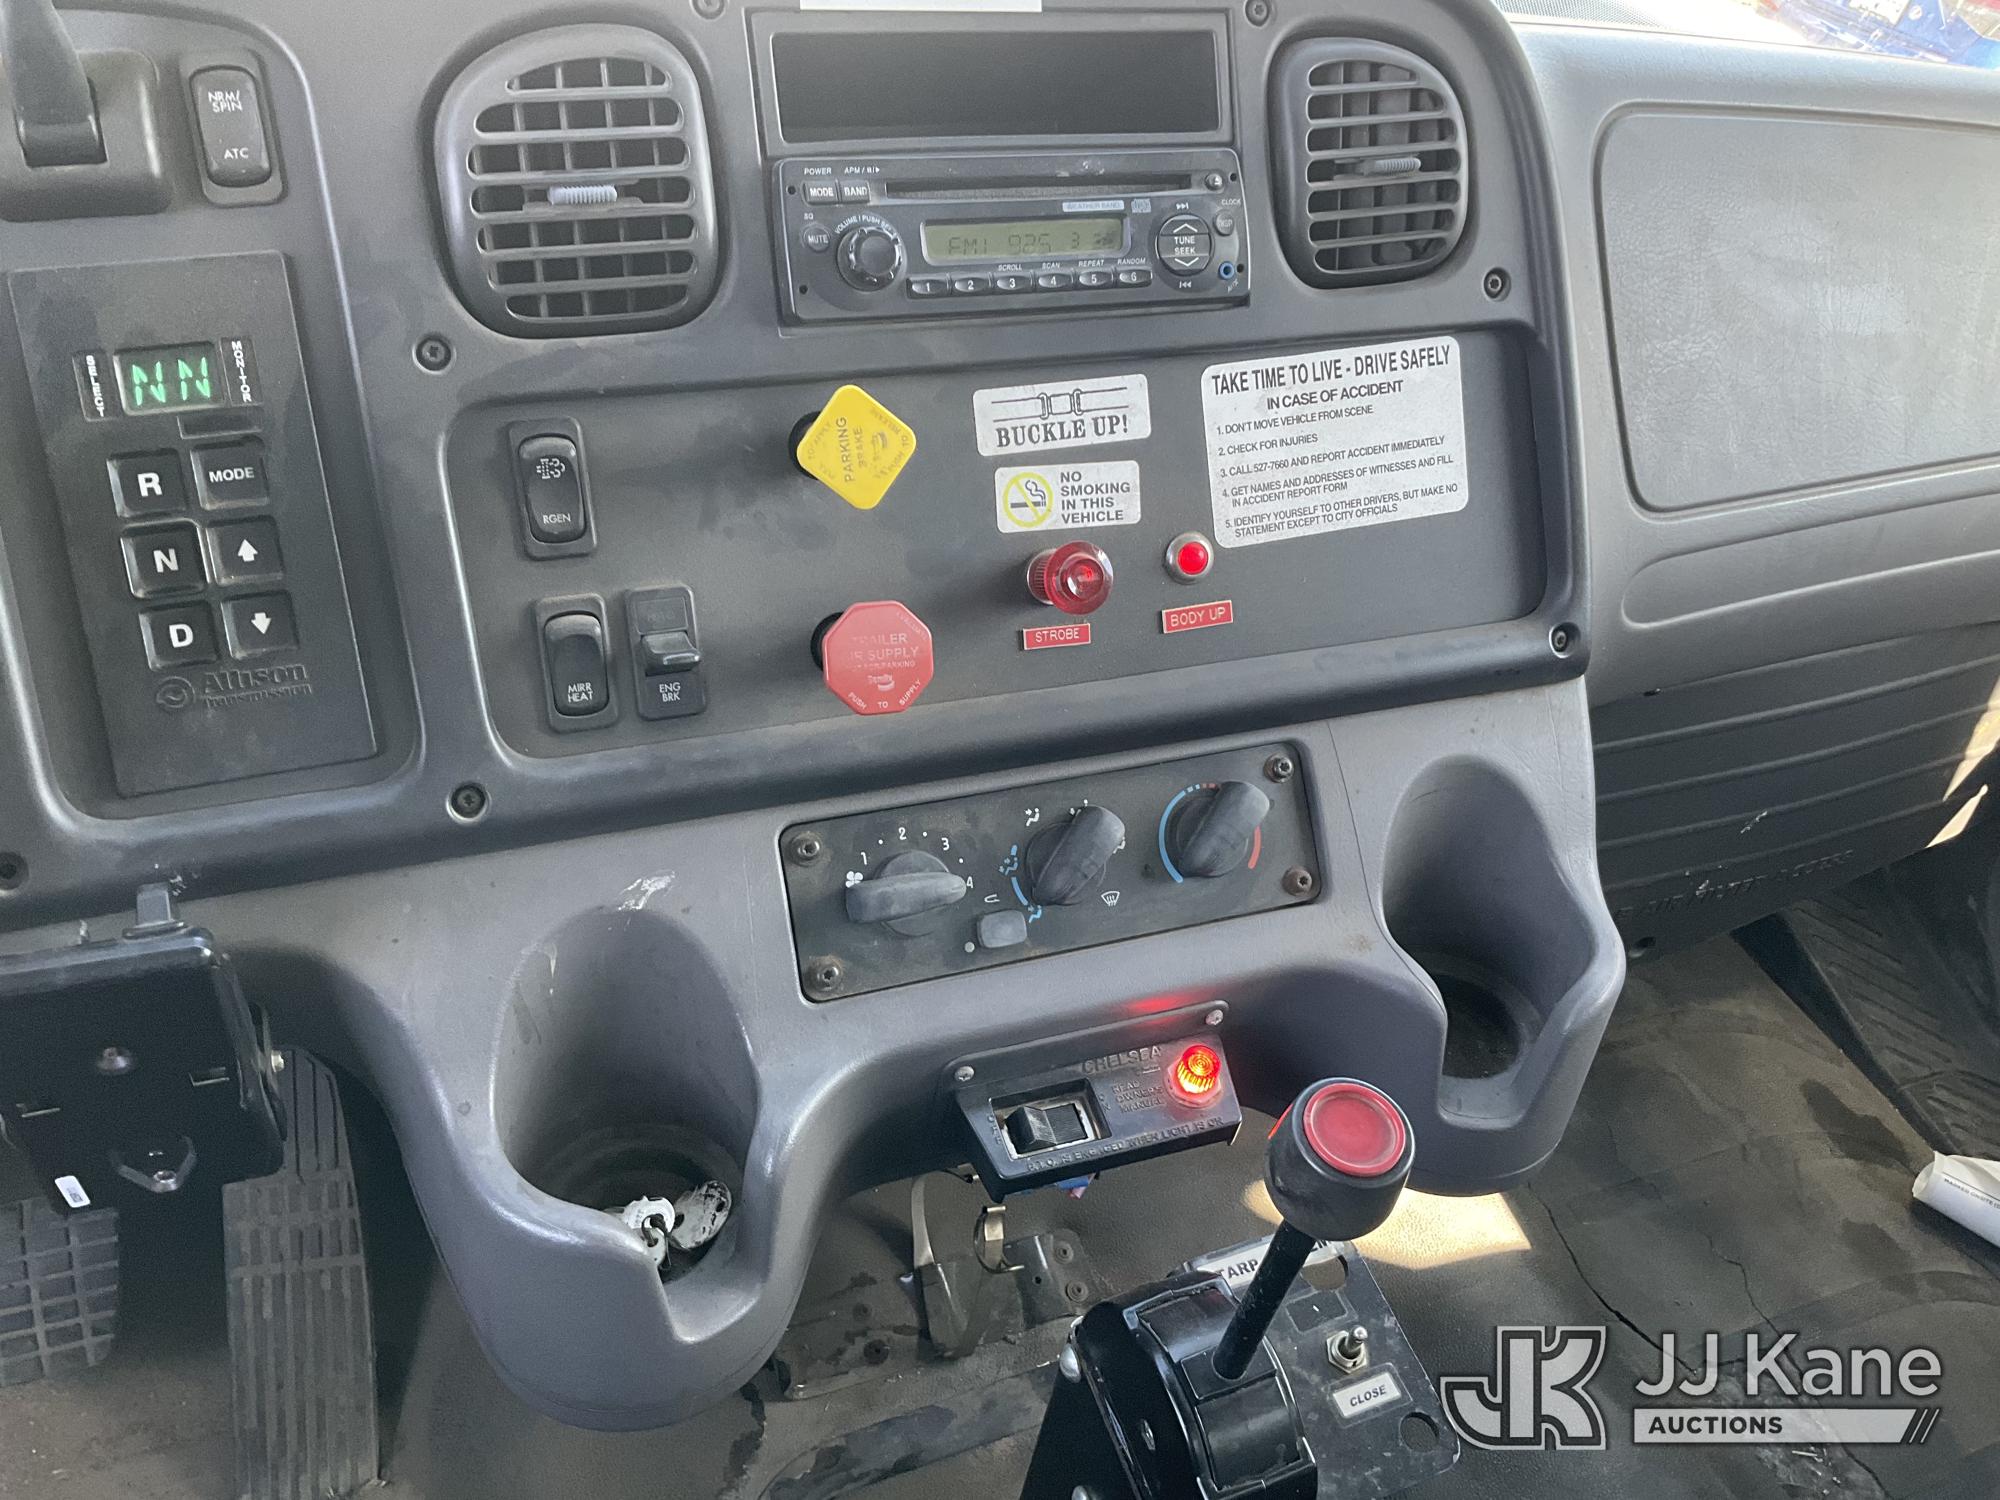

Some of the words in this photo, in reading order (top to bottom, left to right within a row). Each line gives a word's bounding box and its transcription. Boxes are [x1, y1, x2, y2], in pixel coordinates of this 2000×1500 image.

[208, 90, 240, 102] NRM/
[212, 101, 243, 112] SPIN
[223, 147, 249, 159] ATC
[804, 167, 832, 176] POWER
[809, 187, 834, 197] MODE
[843, 186, 868, 197] BAND
[1221, 198, 1241, 206] CLOCK
[835, 215, 858, 234] VOLUME
[862, 215, 880, 224] PUSH
[807, 234, 829, 244] MUTE
[1174, 236, 1195, 245] TUNE
[1174, 247, 1196, 255] SEEK
[998, 263, 1022, 271] SCROLL
[1042, 262, 1060, 270] SCAN
[1078, 259, 1104, 267] REPEAT
[1117, 257, 1146, 265] RANDOM
[1009, 278, 1016, 288] 3
[1050, 276, 1057, 286] 4
[1091, 274, 1097, 284] 5
[1130, 272, 1137, 282] 6
[926, 282, 931, 292] 1
[967, 280, 974, 290] 2
[231, 340, 252, 403] MONITOR
[1212, 371, 1249, 395] TAKE
[1252, 366, 1286, 390] TIME
[1289, 363, 1308, 385] TO
[1312, 359, 1342, 382] LIVE
[1355, 352, 1397, 376] DRIVE
[1400, 345, 1450, 370] SAFELY
[86, 355, 104, 417] SELECT
[1267, 397, 1280, 410] IN
[1282, 392, 1318, 408] CASE
[1320, 389, 1338, 402] OF
[1340, 380, 1404, 400] ACCIDENT
[1217, 426, 1224, 435] 1.
[1225, 420, 1252, 434] DON'T
[1254, 417, 1280, 430] MOVE
[1280, 412, 1317, 426] VEHICLE
[1318, 409, 1344, 421] FROM
[1344, 404, 1374, 417] SCENE
[996, 419, 1086, 448] BUCKLE
[1092, 414, 1128, 437] UP!
[836, 416, 856, 483] PARKING
[853, 425, 867, 469] BRAKE
[1218, 447, 1226, 456] 2.
[1227, 442, 1258, 455] CHECK
[1260, 439, 1278, 450] FOR
[1280, 433, 1319, 447] INJURIES
[1220, 469, 1228, 478] 3.
[1229, 464, 1252, 477] CALL
[1253, 460, 1289, 473] 527-7660
[1291, 456, 1309, 467] AND
[1311, 450, 1346, 463] REPORT
[1347, 444, 1390, 459] ACCIDENT
[1391, 435, 1445, 452] IMMEDIATELY
[209, 467, 255, 483] MODE
[1060, 471, 1082, 483] NO
[1222, 489, 1229, 498] 4.
[1231, 485, 1249, 497] GET
[1250, 480, 1281, 493] NAMES
[1283, 477, 1301, 488] AND
[1303, 469, 1355, 486] ADDRESSES
[1356, 467, 1368, 478] OF
[1369, 459, 1417, 475] WITNESSES
[1418, 457, 1436, 468] AND
[1437, 454, 1454, 466] FILL
[137, 472, 163, 497] R
[1060, 482, 1131, 497] SMOKING
[1232, 499, 1240, 508] IN
[1242, 491, 1285, 506] ACCIDENT
[1287, 485, 1322, 499] REPORT
[1323, 481, 1348, 494] FORM
[1061, 499, 1076, 510] IN
[1081, 497, 1114, 509] THIS
[1225, 520, 1232, 529] 5.
[1234, 512, 1272, 527] IDENTIFY
[1273, 505, 1319, 520] YOURSELF
[1320, 503, 1332, 513] TO
[1333, 499, 1362, 511] OTHER
[1363, 492, 1402, 506] DRIVERS,
[1402, 489, 1419, 500] BUT
[1421, 485, 1444, 497] MAKE
[1445, 483, 1458, 493] NO
[543, 513, 571, 524] RGEN
[1061, 510, 1124, 524] VEHICLE
[1235, 522, 1285, 538] STATEMENT
[1287, 516, 1320, 530] EXCEPT
[1322, 513, 1334, 523] TO
[1335, 510, 1354, 521] CITY
[1355, 503, 1398, 518] OFFICIALS
[153, 548, 179, 573] N
[1170, 609, 1203, 627] BODY
[1209, 606, 1226, 621] UP
[168, 624, 194, 648] D
[1035, 627, 1080, 643] STROBE
[867, 646, 920, 661] SUPPLY
[568, 682, 592, 693] MIRR
[659, 682, 681, 693] ENG
[568, 691, 593, 703] HEAT
[662, 692, 680, 702] BRK
[848, 691, 868, 710] PUSH
[878, 701, 889, 709] TO
[899, 679, 922, 706] SUPPLY
[898, 827, 907, 840] 2
[941, 837, 950, 851] 3
[861, 852, 868, 865] 1
[966, 876, 974, 888] 4
[1082, 1045, 1162, 1074] CHELSEA
[1350, 1384, 1387, 1407] CLOSE
